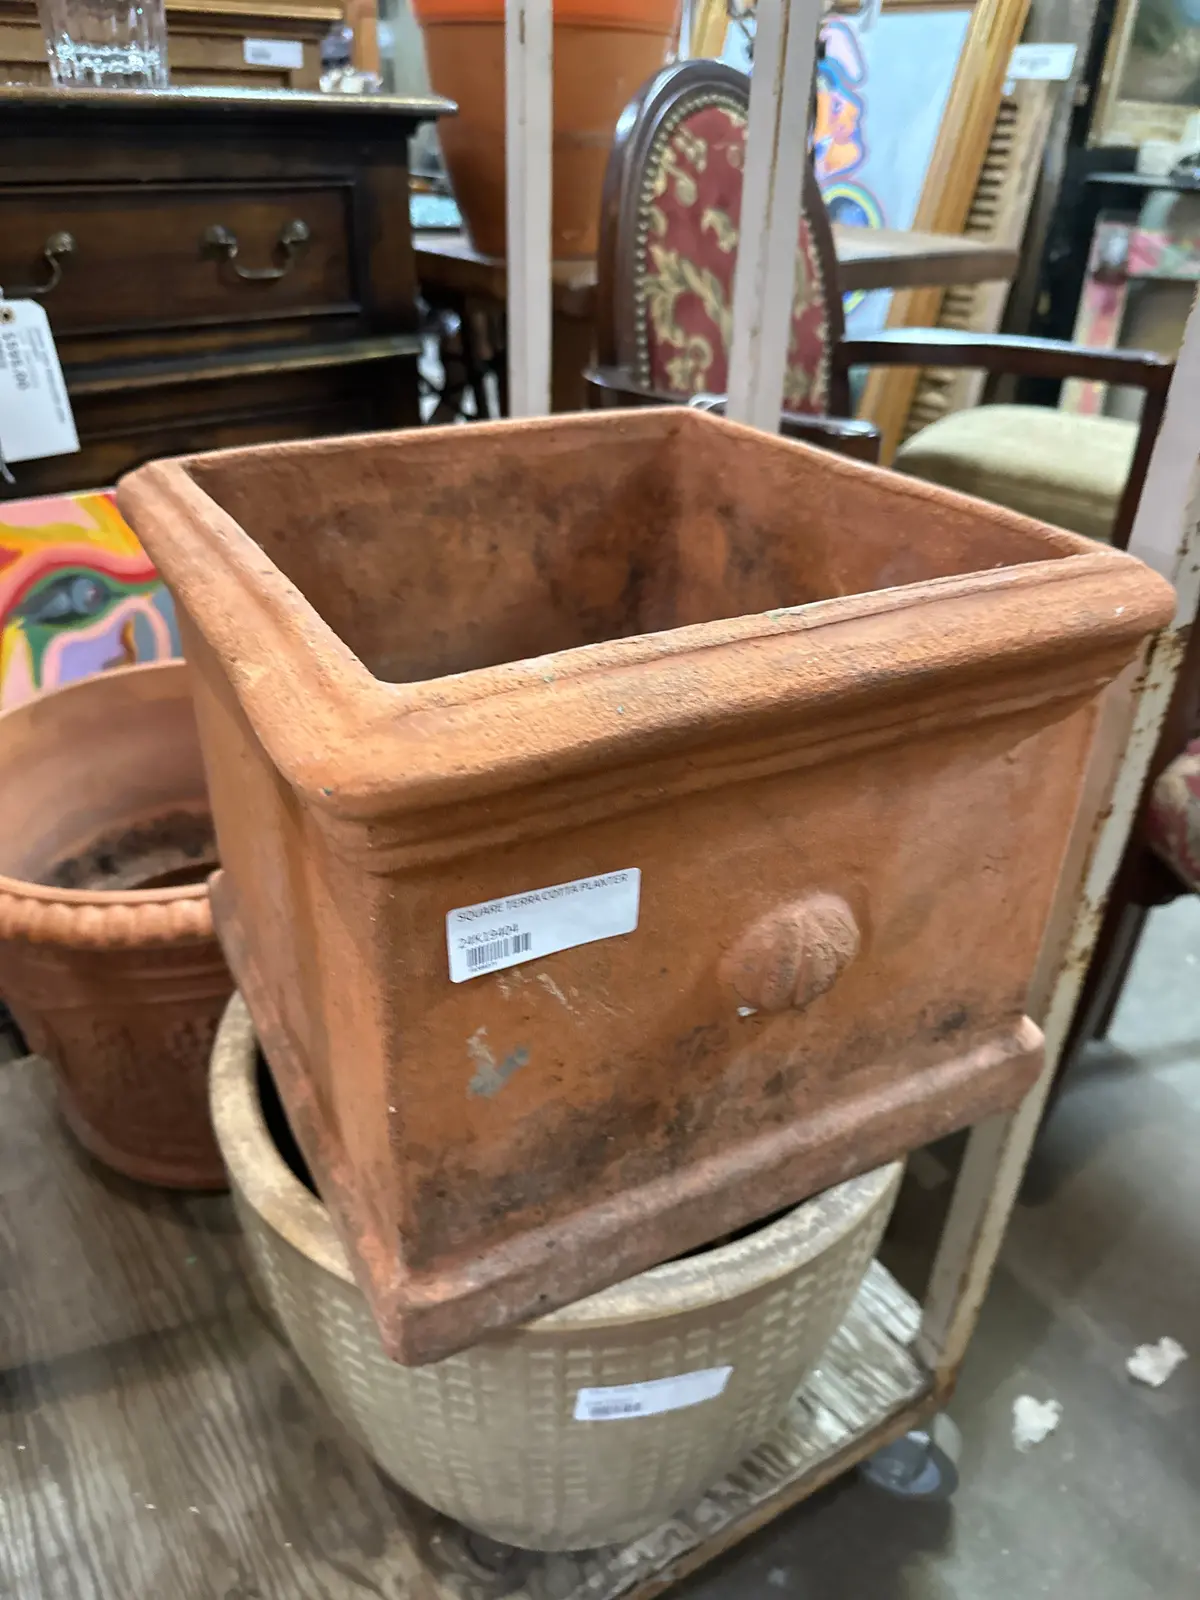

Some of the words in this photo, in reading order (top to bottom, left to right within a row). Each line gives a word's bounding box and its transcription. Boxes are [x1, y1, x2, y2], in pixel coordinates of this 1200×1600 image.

[457, 903, 503, 922] SQUARE
[506, 895, 540, 910] TERRA
[542, 886, 579, 901] COTTA
[580, 873, 628, 892] PLANTER
